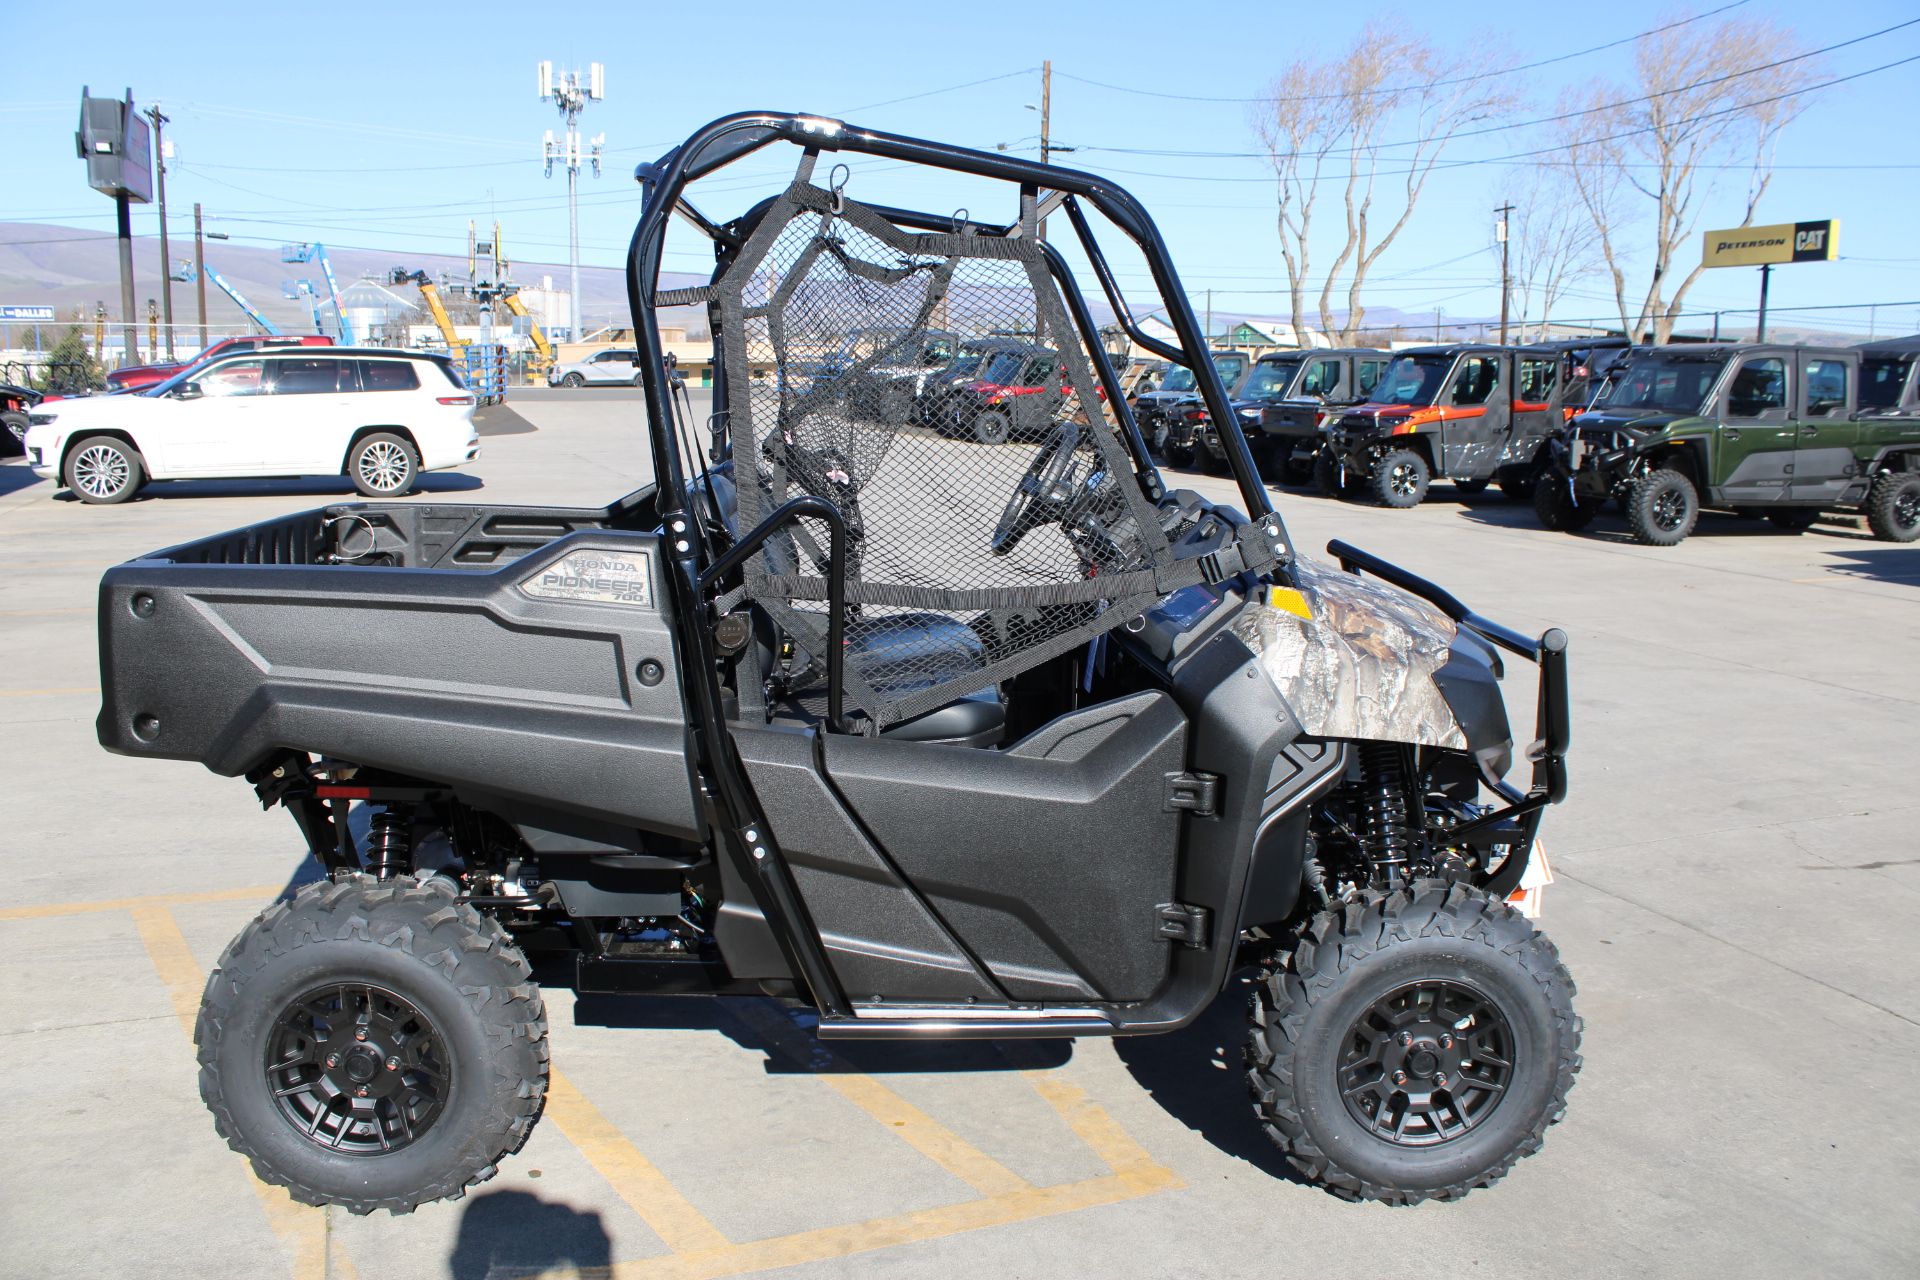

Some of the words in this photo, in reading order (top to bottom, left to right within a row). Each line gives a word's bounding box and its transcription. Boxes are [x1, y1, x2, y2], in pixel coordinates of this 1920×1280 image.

[1716, 238, 1786, 254] PETERSON
[1796, 229, 1827, 251] CAT
[15, 308, 53, 318] DALLES
[574, 559, 639, 572] HONDA
[543, 574, 644, 593] PIONEER
[611, 592, 644, 602] 700
